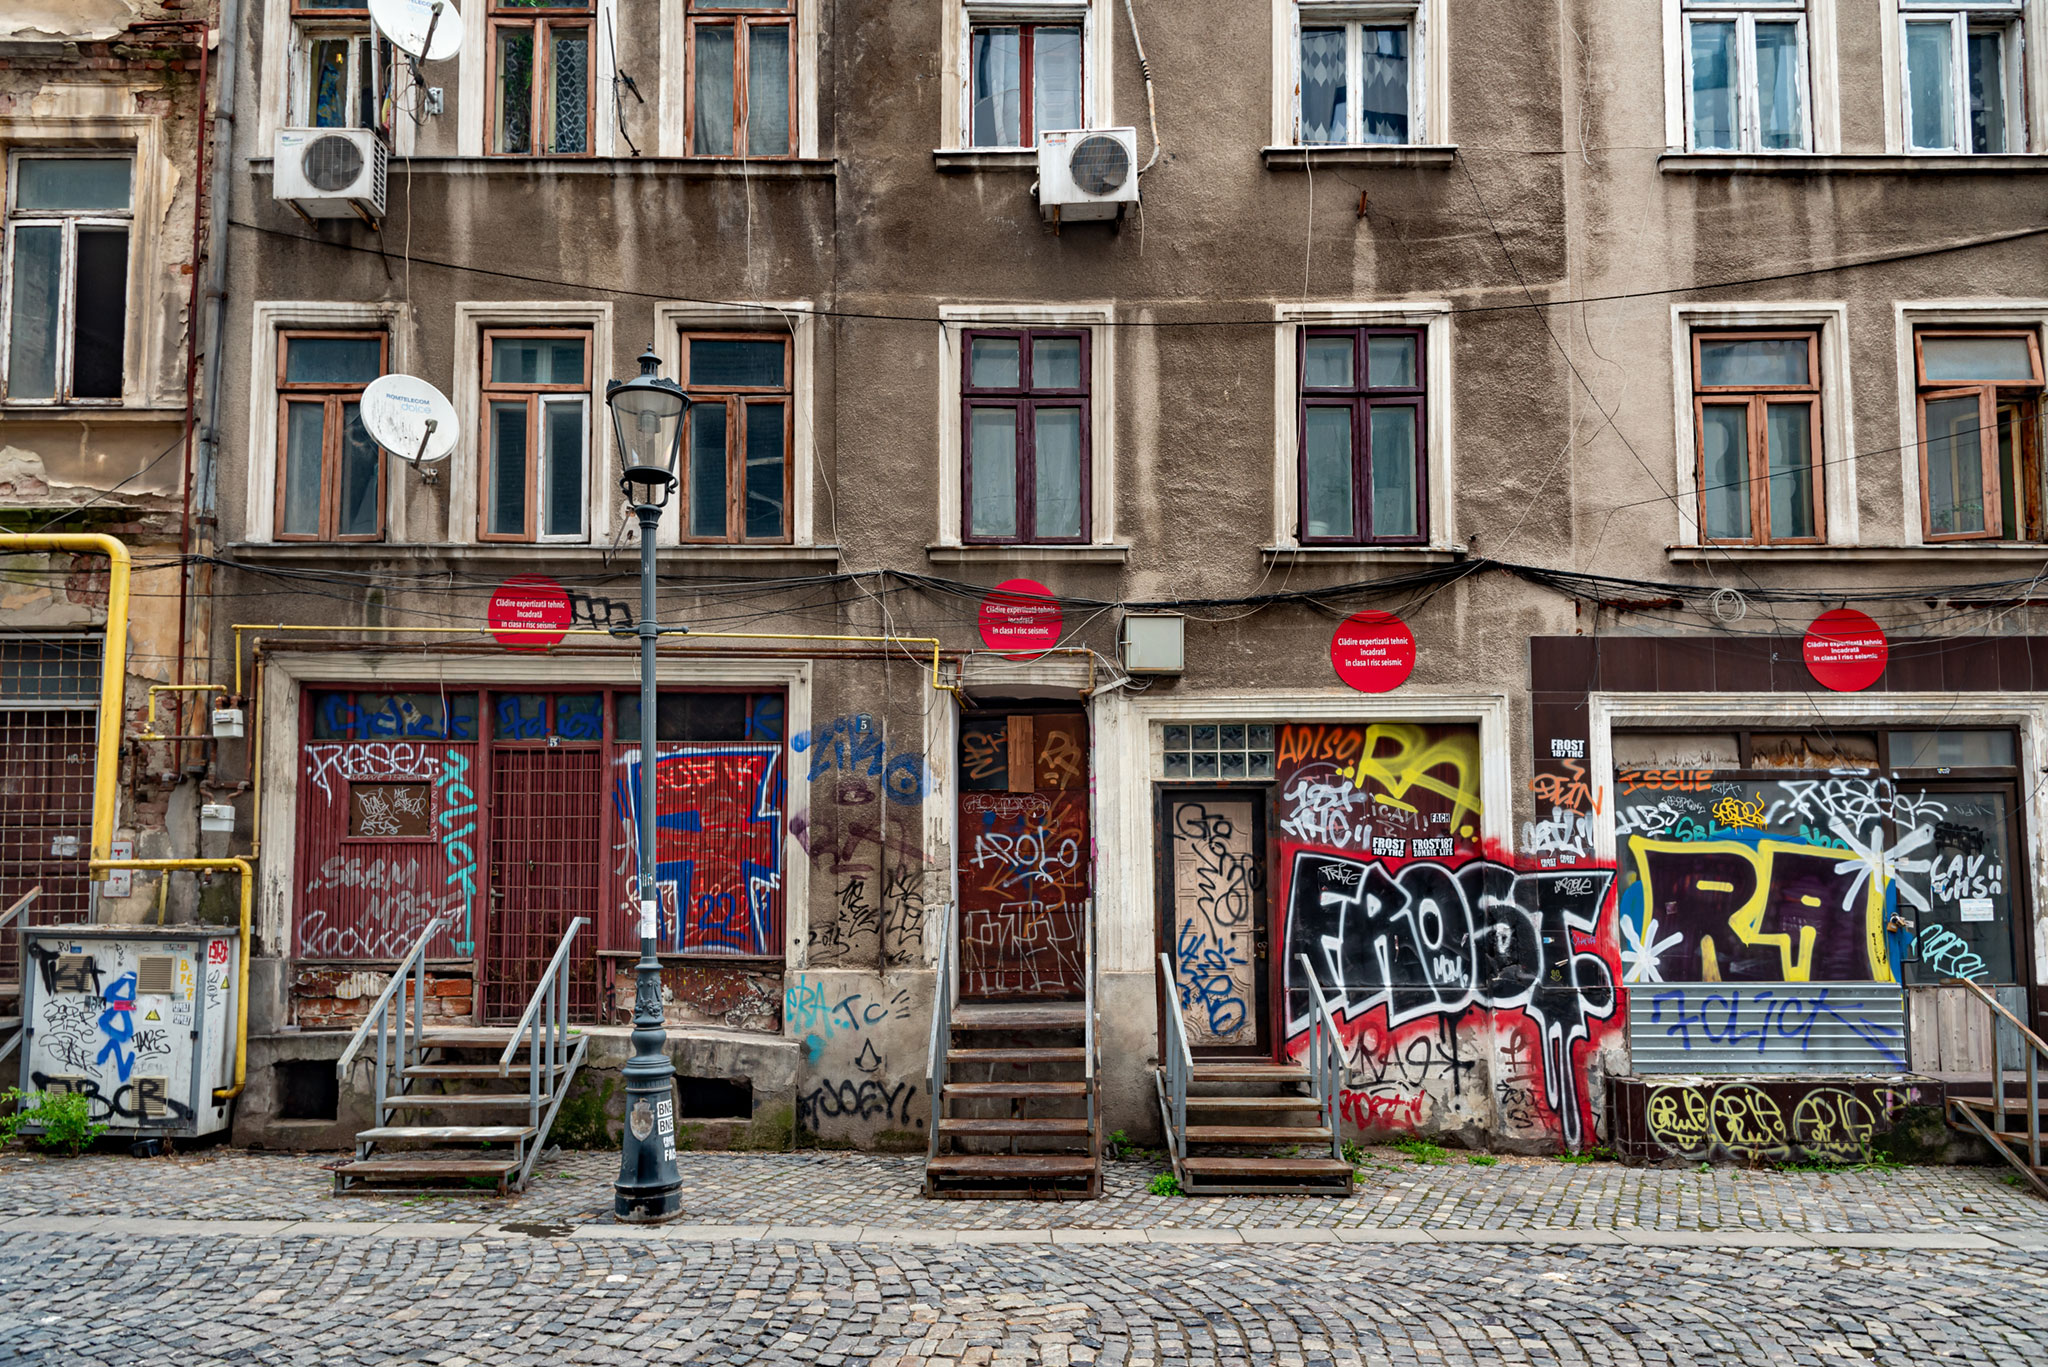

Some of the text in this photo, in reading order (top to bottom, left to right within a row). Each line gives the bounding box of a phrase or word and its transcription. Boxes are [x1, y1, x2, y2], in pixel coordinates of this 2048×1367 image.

[386, 392, 430, 405] ROMTELECOM
[401, 402, 432, 414] dolce
[495, 598, 565, 609] Clădire expertizată tehnic
[985, 605, 1006, 614] Clădire
[1037, 606, 1056, 614] tehnic
[526, 621, 535, 629] risc
[536, 621, 557, 630] seismic
[999, 626, 1013, 635] clasa
[1013, 626, 1017, 635] I
[1017, 626, 1027, 635] risc
[1027, 626, 1049, 635] seismic
[1337, 636, 1408, 647] Clădire expertizată tehnic
[1806, 641, 1828, 649] Clădire
[1360, 647, 1387, 656] încadrată
[1352, 658, 1366, 667] clasa
[1366, 658, 1370, 667] I
[1370, 658, 1381, 667] risc
[1381, 658, 1403, 667] seismic
[860, 720, 868, 730] 5
[1551, 739, 1585, 751] FROST
[1551, 750, 1584, 758] 187 THC
[1619, 769, 1713, 796] ISSUE
[1430, 813, 1451, 823] FACH
[1372, 837, 1406, 850] FROST
[1372, 848, 1404, 857] 187 THC
[1413, 848, 1454, 857] ZOMBIE LIFE
